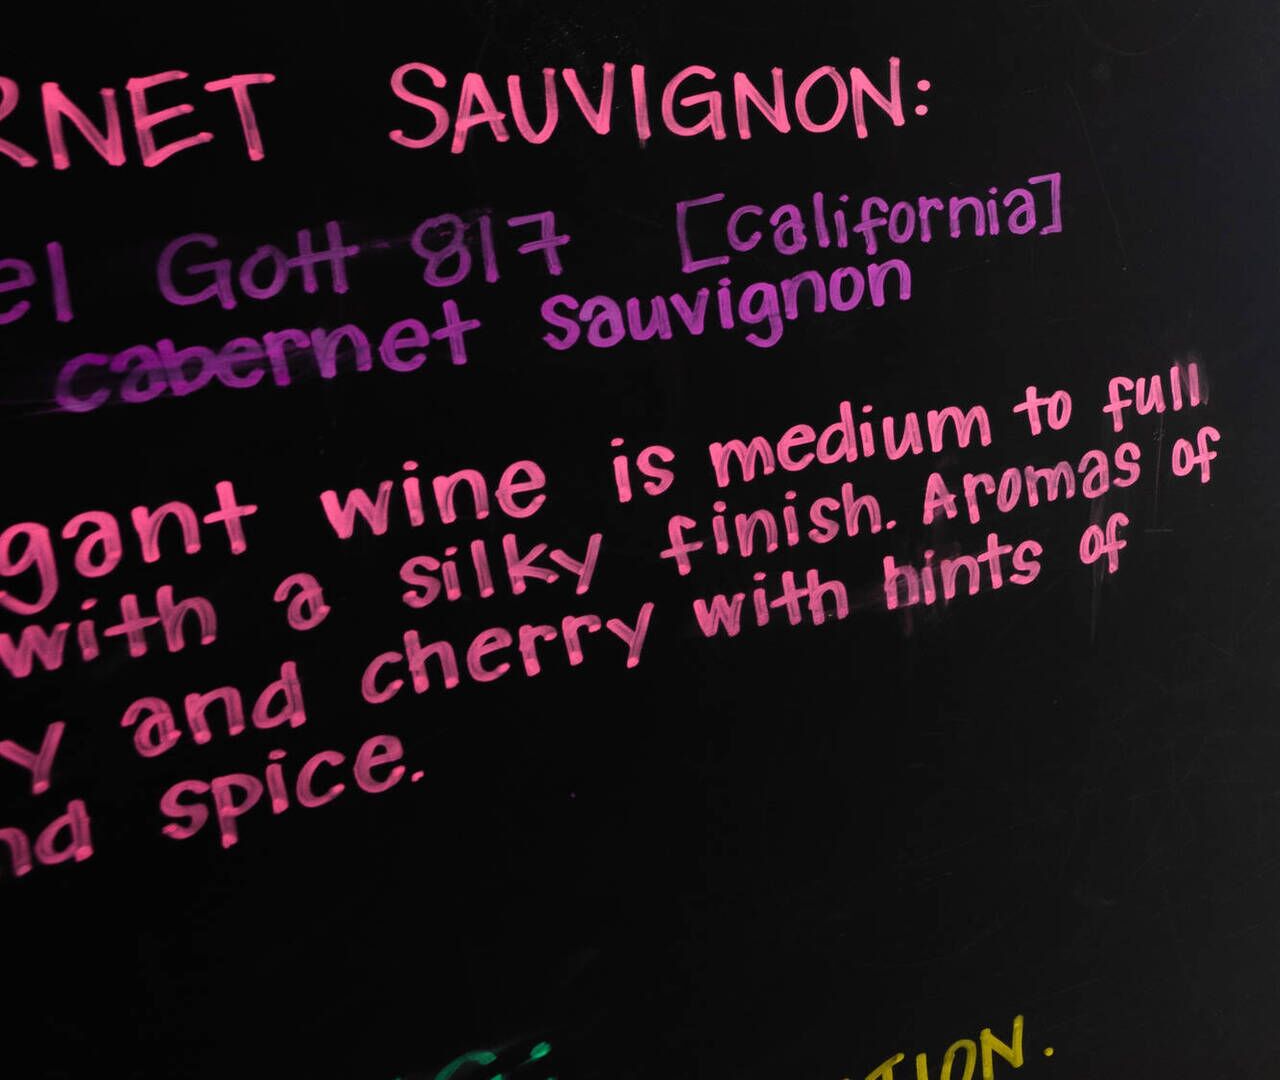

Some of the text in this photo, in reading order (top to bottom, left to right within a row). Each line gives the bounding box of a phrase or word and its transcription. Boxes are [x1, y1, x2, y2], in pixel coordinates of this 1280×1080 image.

[390, 57, 932, 152] SAUVIGNON:
[54, 258, 913, 413] cabernet sauvignon
[157, 220, 360, 309] Gott
[411, 211, 570, 288] 817
[320, 361, 1204, 542] wine is medium to full
[0, 426, 1221, 677] with a silky finish. Aromas of
[121, 514, 1130, 758] and cherry with hints of
[162, 735, 424, 848] spice.
